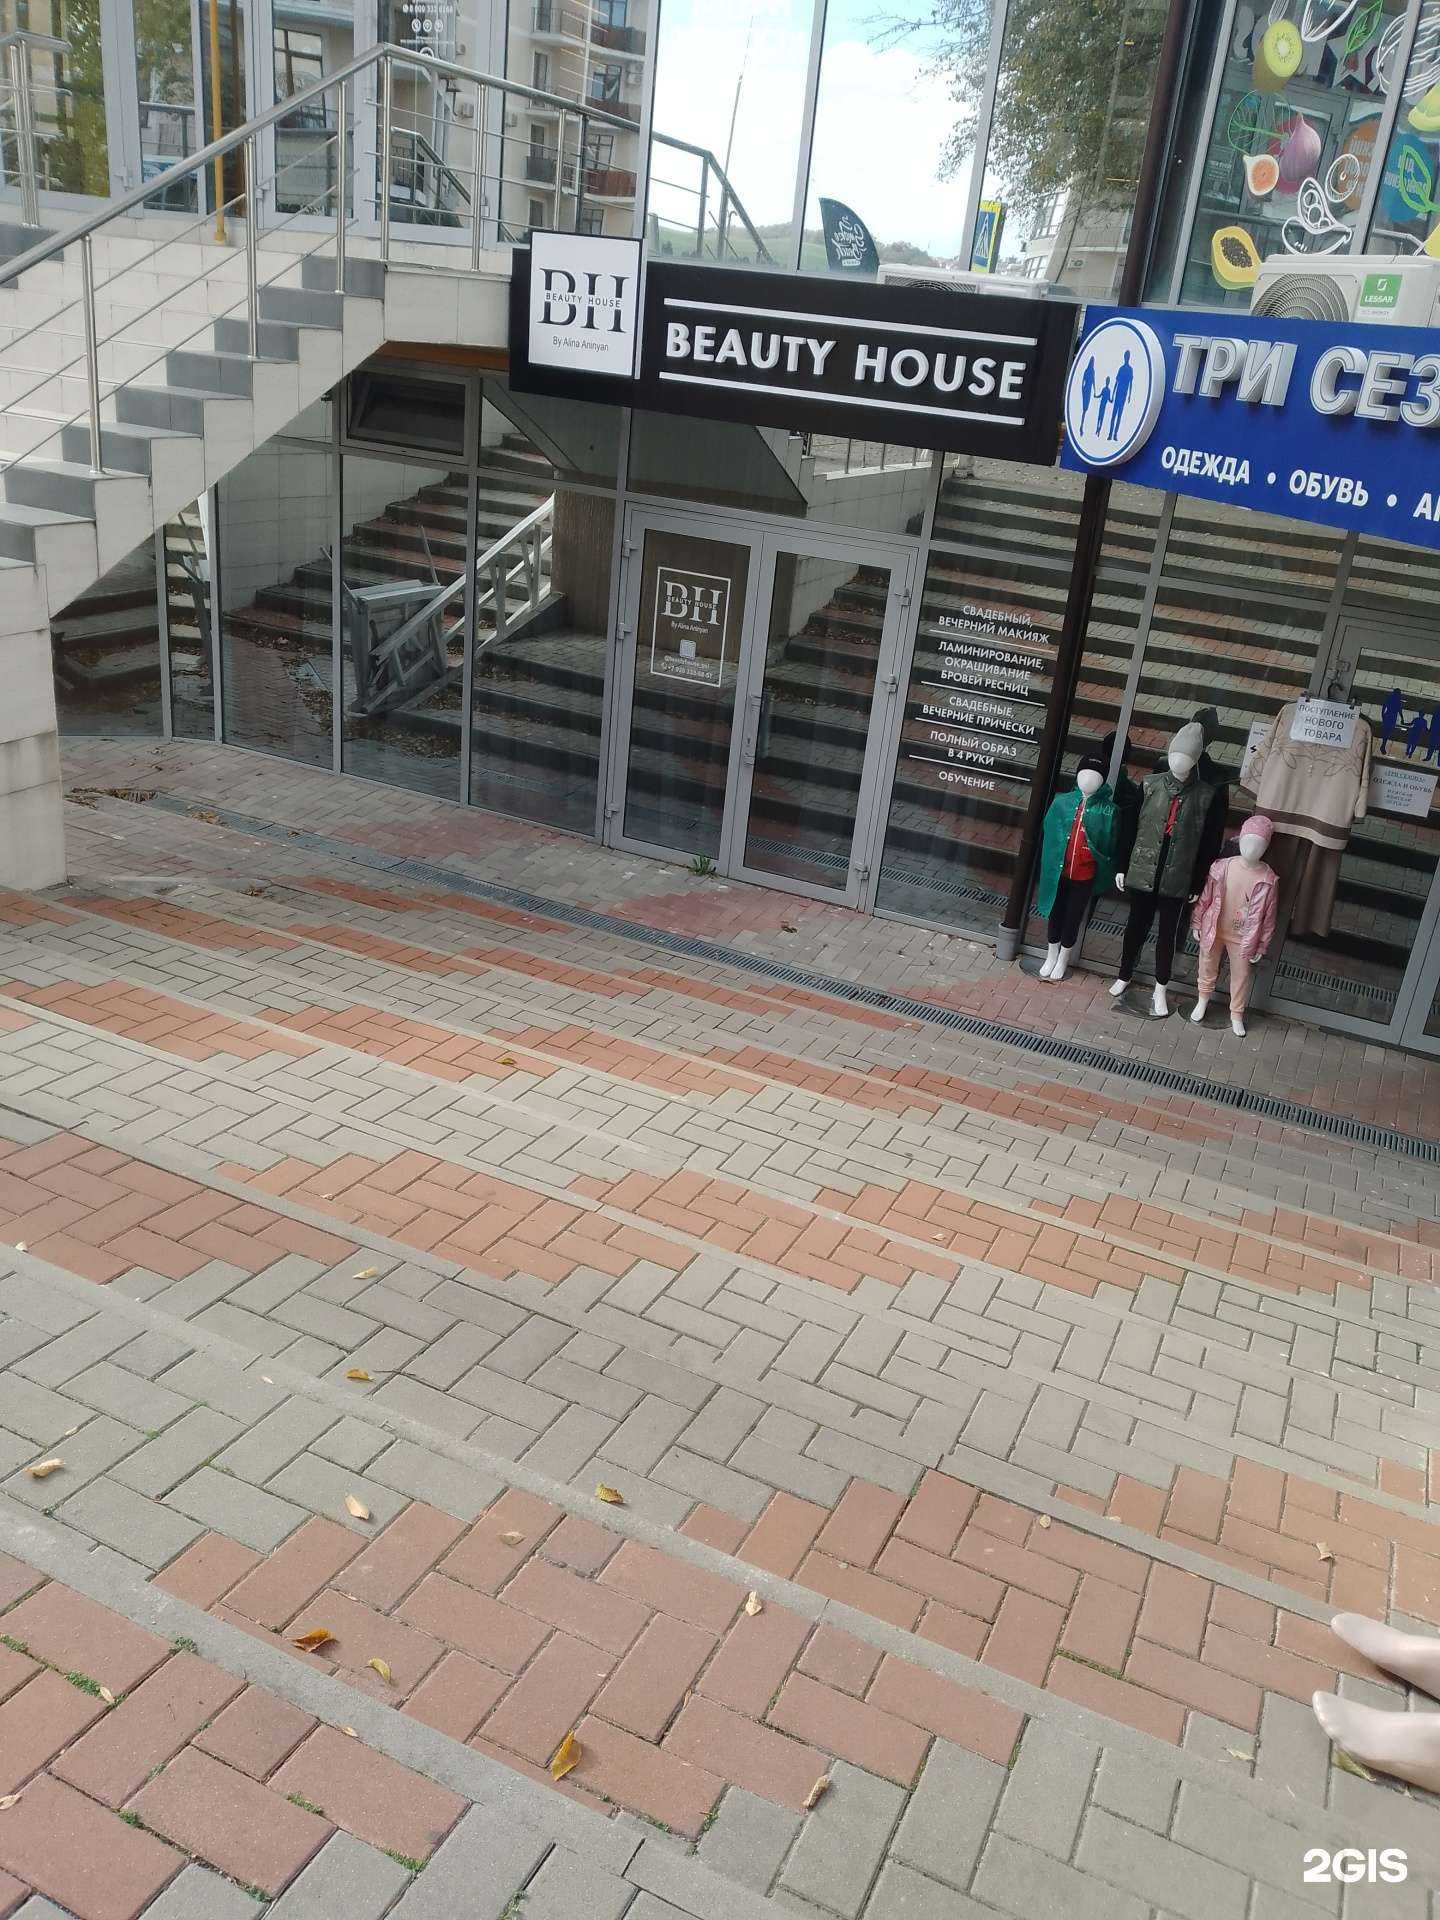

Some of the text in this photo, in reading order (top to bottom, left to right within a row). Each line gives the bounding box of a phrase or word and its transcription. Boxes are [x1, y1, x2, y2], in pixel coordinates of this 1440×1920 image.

[537, 267, 630, 334] BH
[546, 292, 621, 308] BEAUTY HOUSE
[1364, 295, 1394, 303] LESSAR
[552, 335, 609, 352] By Alina Aninyan
[665, 322, 1027, 400] BEAUTY HOUSE
[1172, 333, 1440, 428] ТРИ СЕЗ
[1161, 446, 1440, 522] ОДЕЖДА ОБУВЬ А
[661, 581, 724, 626] BH
[962, 605, 1033, 628] СВАДЕБНЫЙ,
[938, 616, 1050, 644] ВЕЧЕРНИЙ МАКИЯЖ
[938, 641, 1045, 670] ЛАМИНИРОВАНИЕ,
[944, 656, 1031, 681] ОКРАШИВАНИЕ
[940, 670, 1029, 696] БРОВЕЙ РЕСНИЦ
[949, 696, 1015, 718] СВАДЕБНЫЕ,
[1298, 704, 1356, 720] ПОСТУПЛЕНИЕ
[922, 704, 1035, 736] ВЕЧЕРНИЕ ПРИЧЕСКИ
[1305, 716, 1344, 730] НОВОГО
[930, 730, 1017, 757] ПОЛНЫЙ ОБРАЗ
[1303, 728, 1342, 743] ТОВАРА
[947, 747, 995, 766] В 4 РУКИ
[938, 770, 996, 791] ОБУЧЕНИЕ
